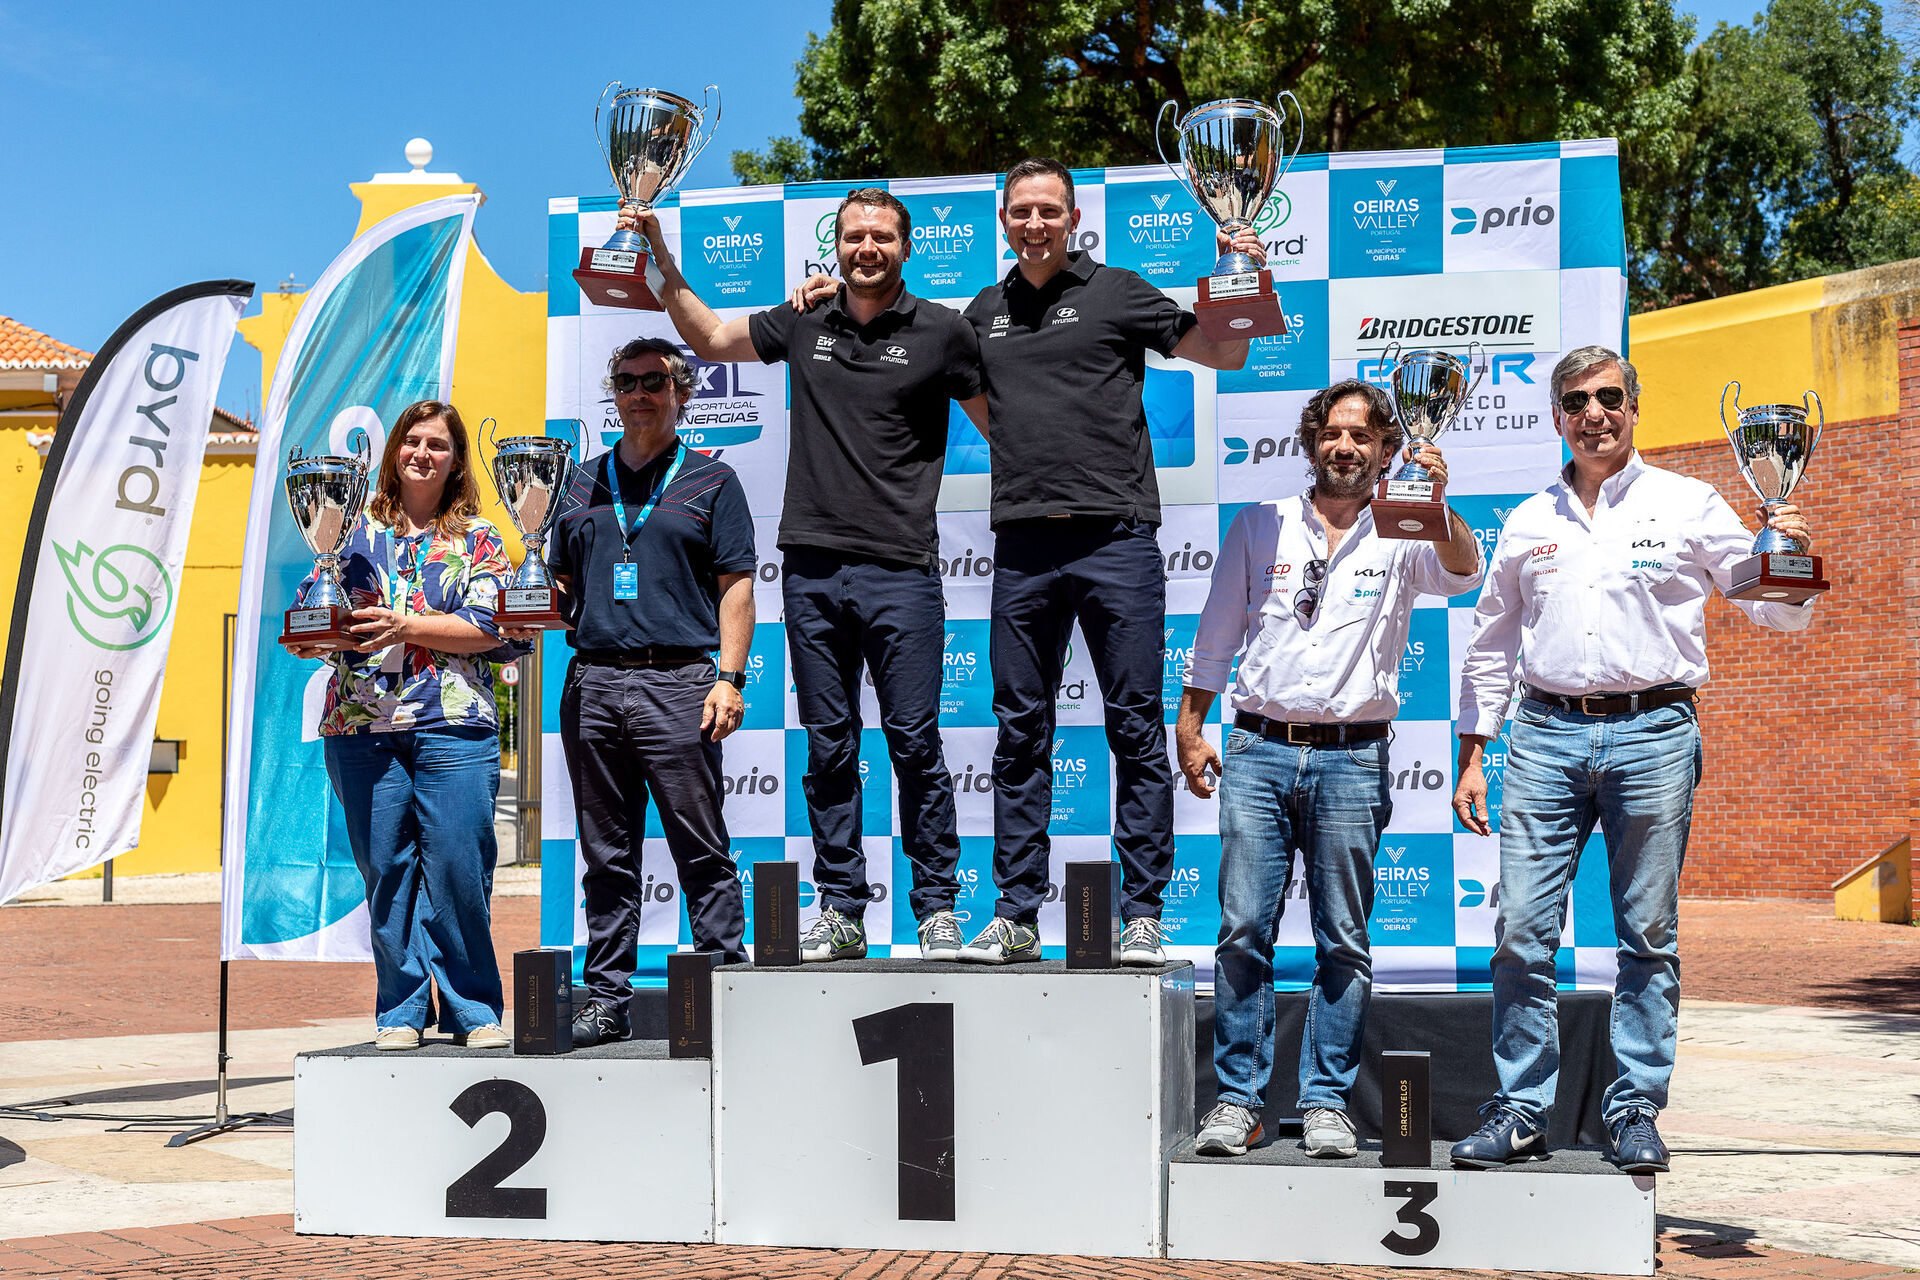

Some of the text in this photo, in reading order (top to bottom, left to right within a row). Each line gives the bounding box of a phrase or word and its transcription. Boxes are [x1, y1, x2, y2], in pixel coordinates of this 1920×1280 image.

[1353, 198, 1420, 214] OEIRAS
[1128, 212, 1193, 228] OEIRAS
[1353, 214, 1420, 230] VALLEY
[1481, 197, 1555, 234] prio
[912, 224, 974, 239] OEIRAS
[1128, 227, 1193, 243] VALLEY
[703, 233, 763, 250] OEIRAS
[912, 239, 974, 254] VALLEY
[1068, 231, 1099, 251] io
[703, 248, 764, 264] VALLEY
[1268, 258, 1301, 266] electric
[805, 260, 840, 278] by
[1052, 317, 1079, 325] HYUNDAI
[1357, 314, 1534, 340] BRIDGESTONE
[1249, 329, 1304, 346] ALLEY
[880, 355, 909, 365] HYUNDAI
[1357, 353, 1536, 389] E-R
[692, 401, 757, 410] PORTUGAL
[1464, 395, 1506, 410] ECO
[684, 411, 759, 425] NERGIAS
[1447, 415, 1539, 431] LLY CUP
[115, 343, 199, 517] byrd
[679, 429, 705, 444] rio
[1253, 429, 1301, 464] pri
[1531, 543, 1557, 556] acp
[1632, 539, 1665, 549] KIA
[1162, 543, 1213, 571] rio
[1640, 559, 1662, 569] prio
[1265, 564, 1291, 575] acp
[1355, 568, 1386, 578] KIA
[943, 652, 977, 666] RAS
[943, 667, 977, 681] LEY
[1055, 680, 1085, 700] rd
[76, 669, 114, 849] going electric
[1052, 758, 1087, 772] RAS
[952, 764, 992, 793] rio
[1052, 774, 1087, 788] LEY
[1171, 867, 1200, 881] RAS
[643, 874, 674, 903] io
[1082, 886, 1090, 941] CARCAVELOS
[852, 1002, 956, 1221] 1
[1400, 1079, 1408, 1137] CARCAVELOS
[445, 1078, 548, 1219] 2
[1380, 1180, 1441, 1255] 3
